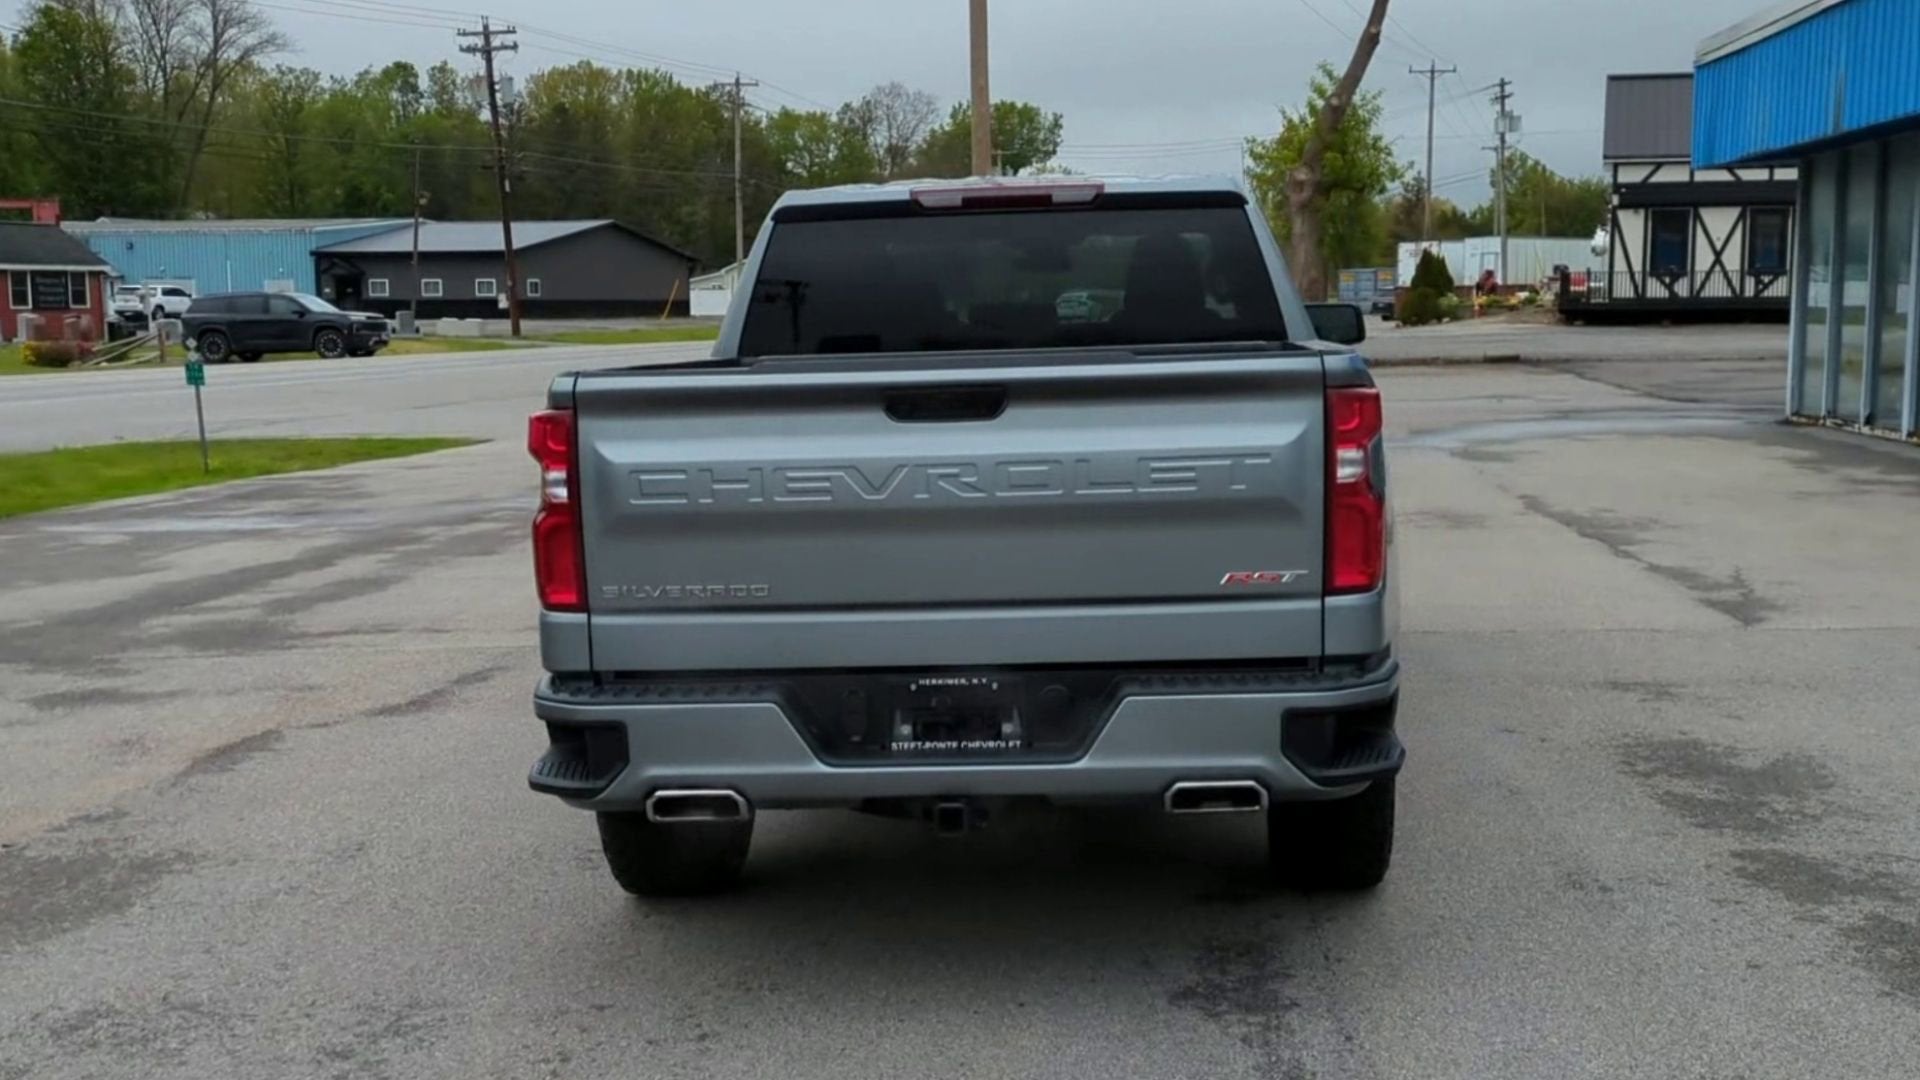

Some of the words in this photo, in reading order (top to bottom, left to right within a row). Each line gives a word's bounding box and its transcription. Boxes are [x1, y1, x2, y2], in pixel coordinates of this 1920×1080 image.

[629, 453, 1272, 503] CHEVROLET
[1219, 570, 1309, 587] RST
[602, 584, 770, 598] SILVERADO
[960, 739, 1022, 750] CHEVROLET
